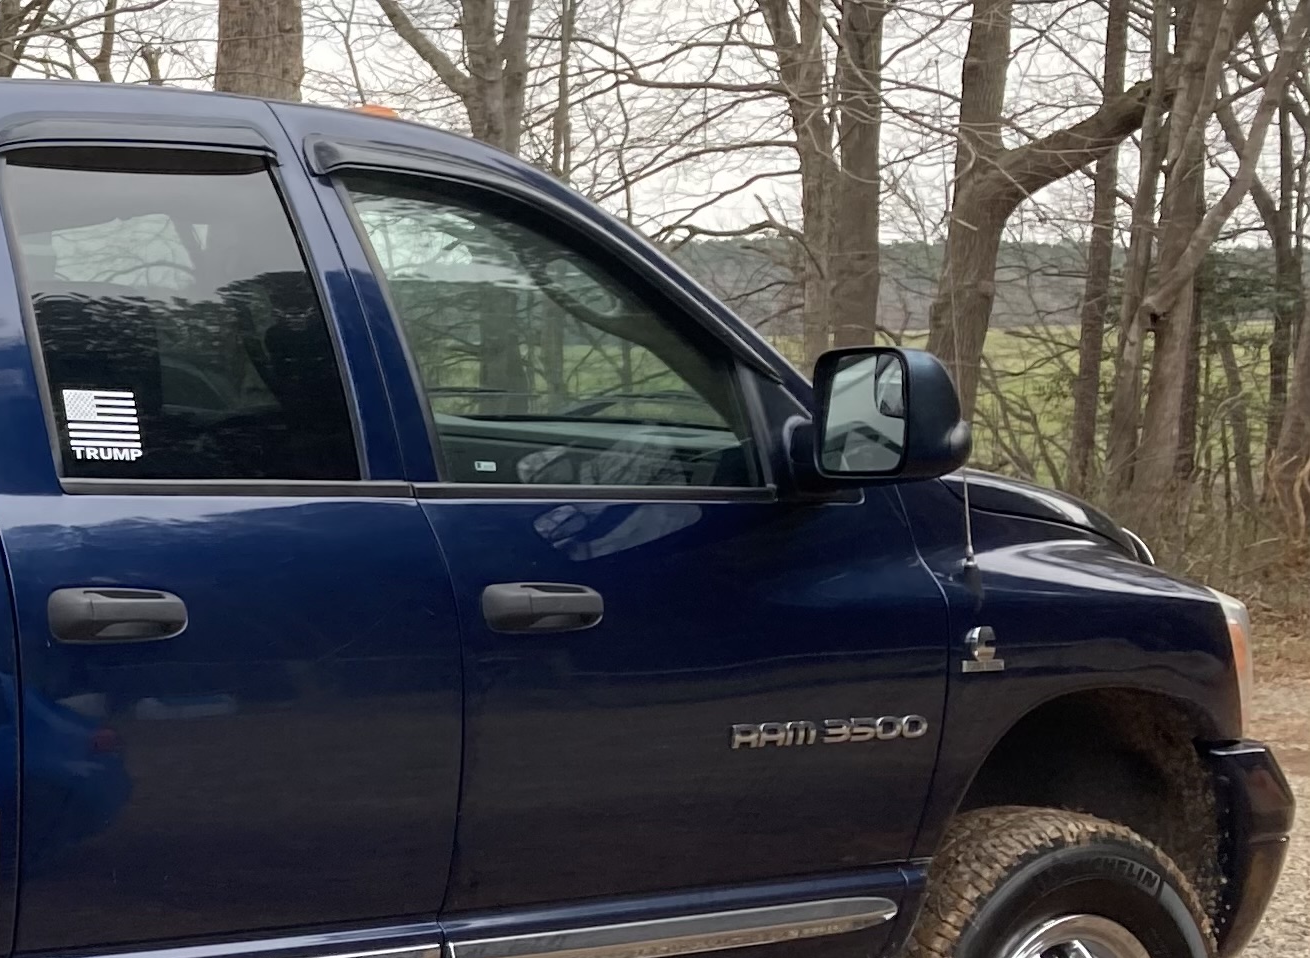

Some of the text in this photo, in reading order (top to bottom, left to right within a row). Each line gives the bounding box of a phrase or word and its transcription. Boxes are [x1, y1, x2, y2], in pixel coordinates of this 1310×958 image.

[71, 446, 143, 461] TRUMP
[732, 714, 929, 749] RAM 3500
